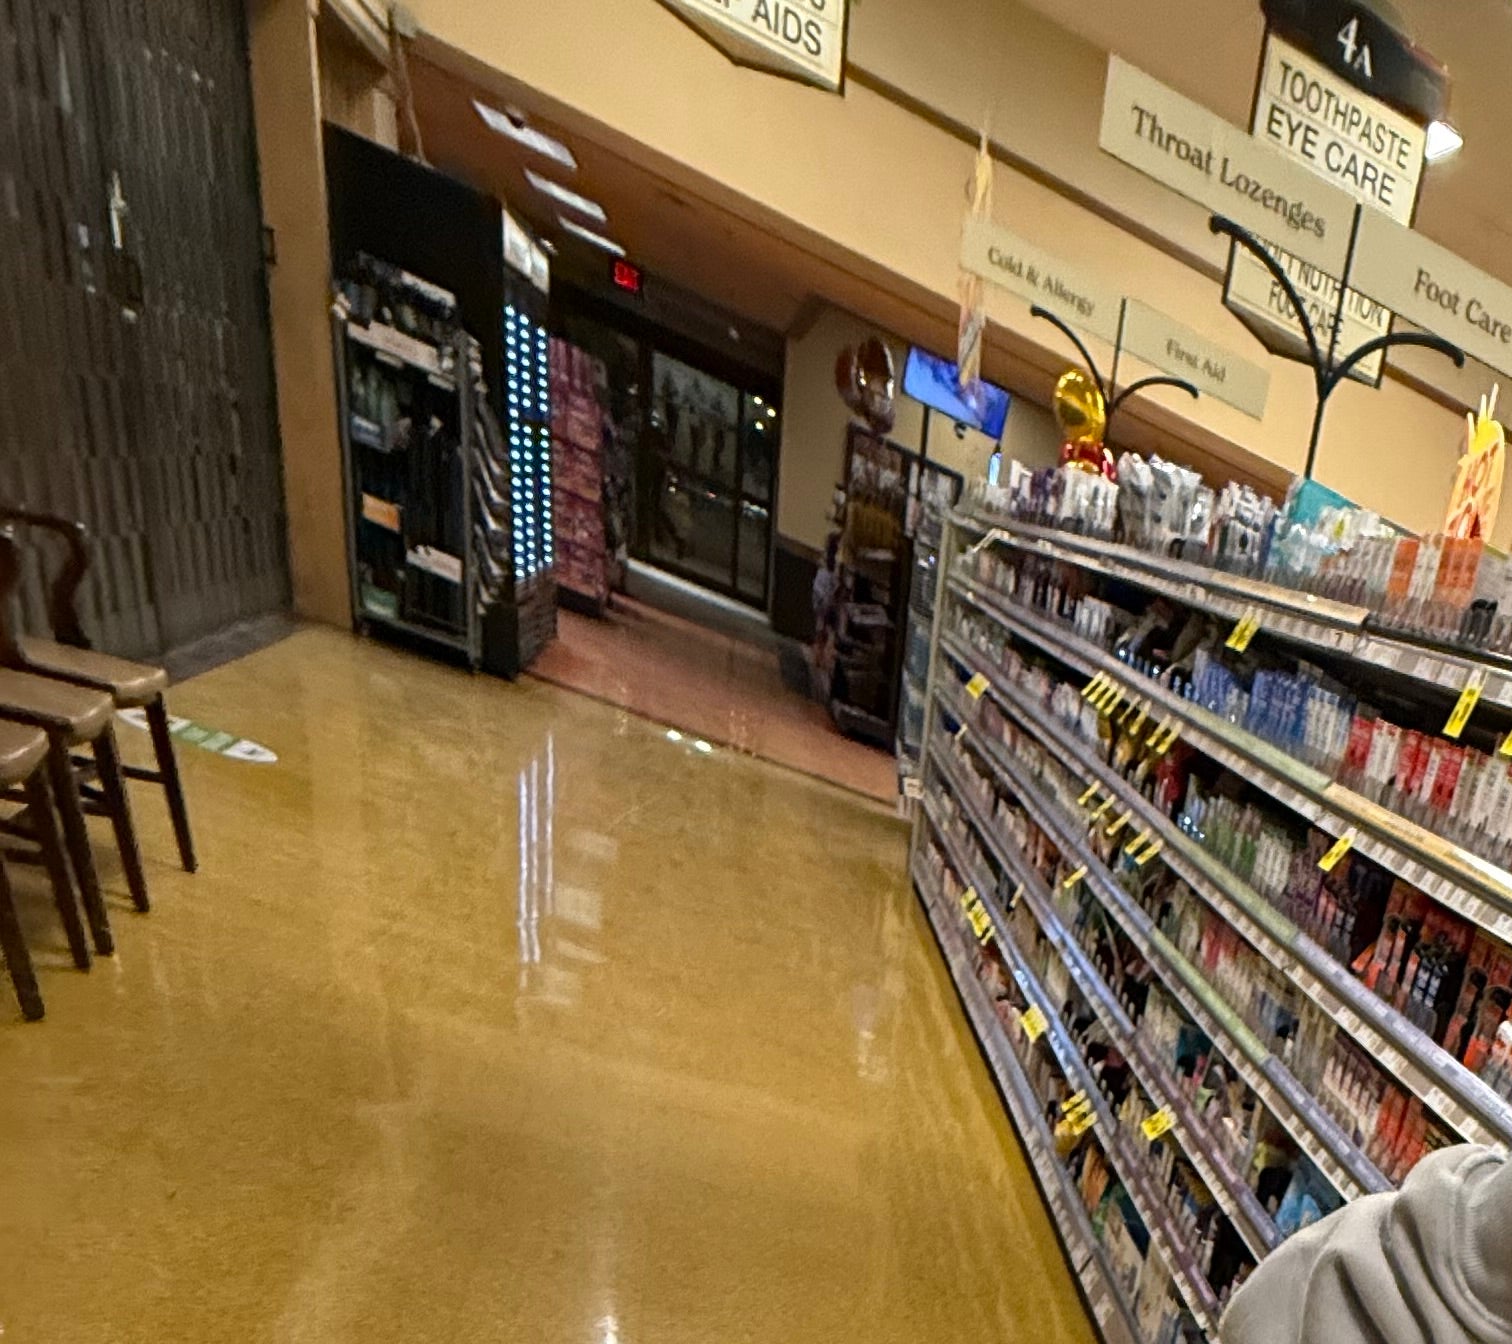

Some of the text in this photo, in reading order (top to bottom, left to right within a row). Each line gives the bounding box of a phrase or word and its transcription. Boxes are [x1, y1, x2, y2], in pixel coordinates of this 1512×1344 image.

[752, 0, 822, 56] AIDS
[1280, 60, 1410, 170] TOOTHPASTE
[1131, 105, 1326, 237] Throat Lozenges
[1266, 105, 1396, 208] EYE CARE
[988, 246, 1023, 280] Cold
[1042, 271, 1095, 317] Allergy
[1414, 266, 1512, 344] Foot Care
[1166, 337, 1226, 384] First Aid
